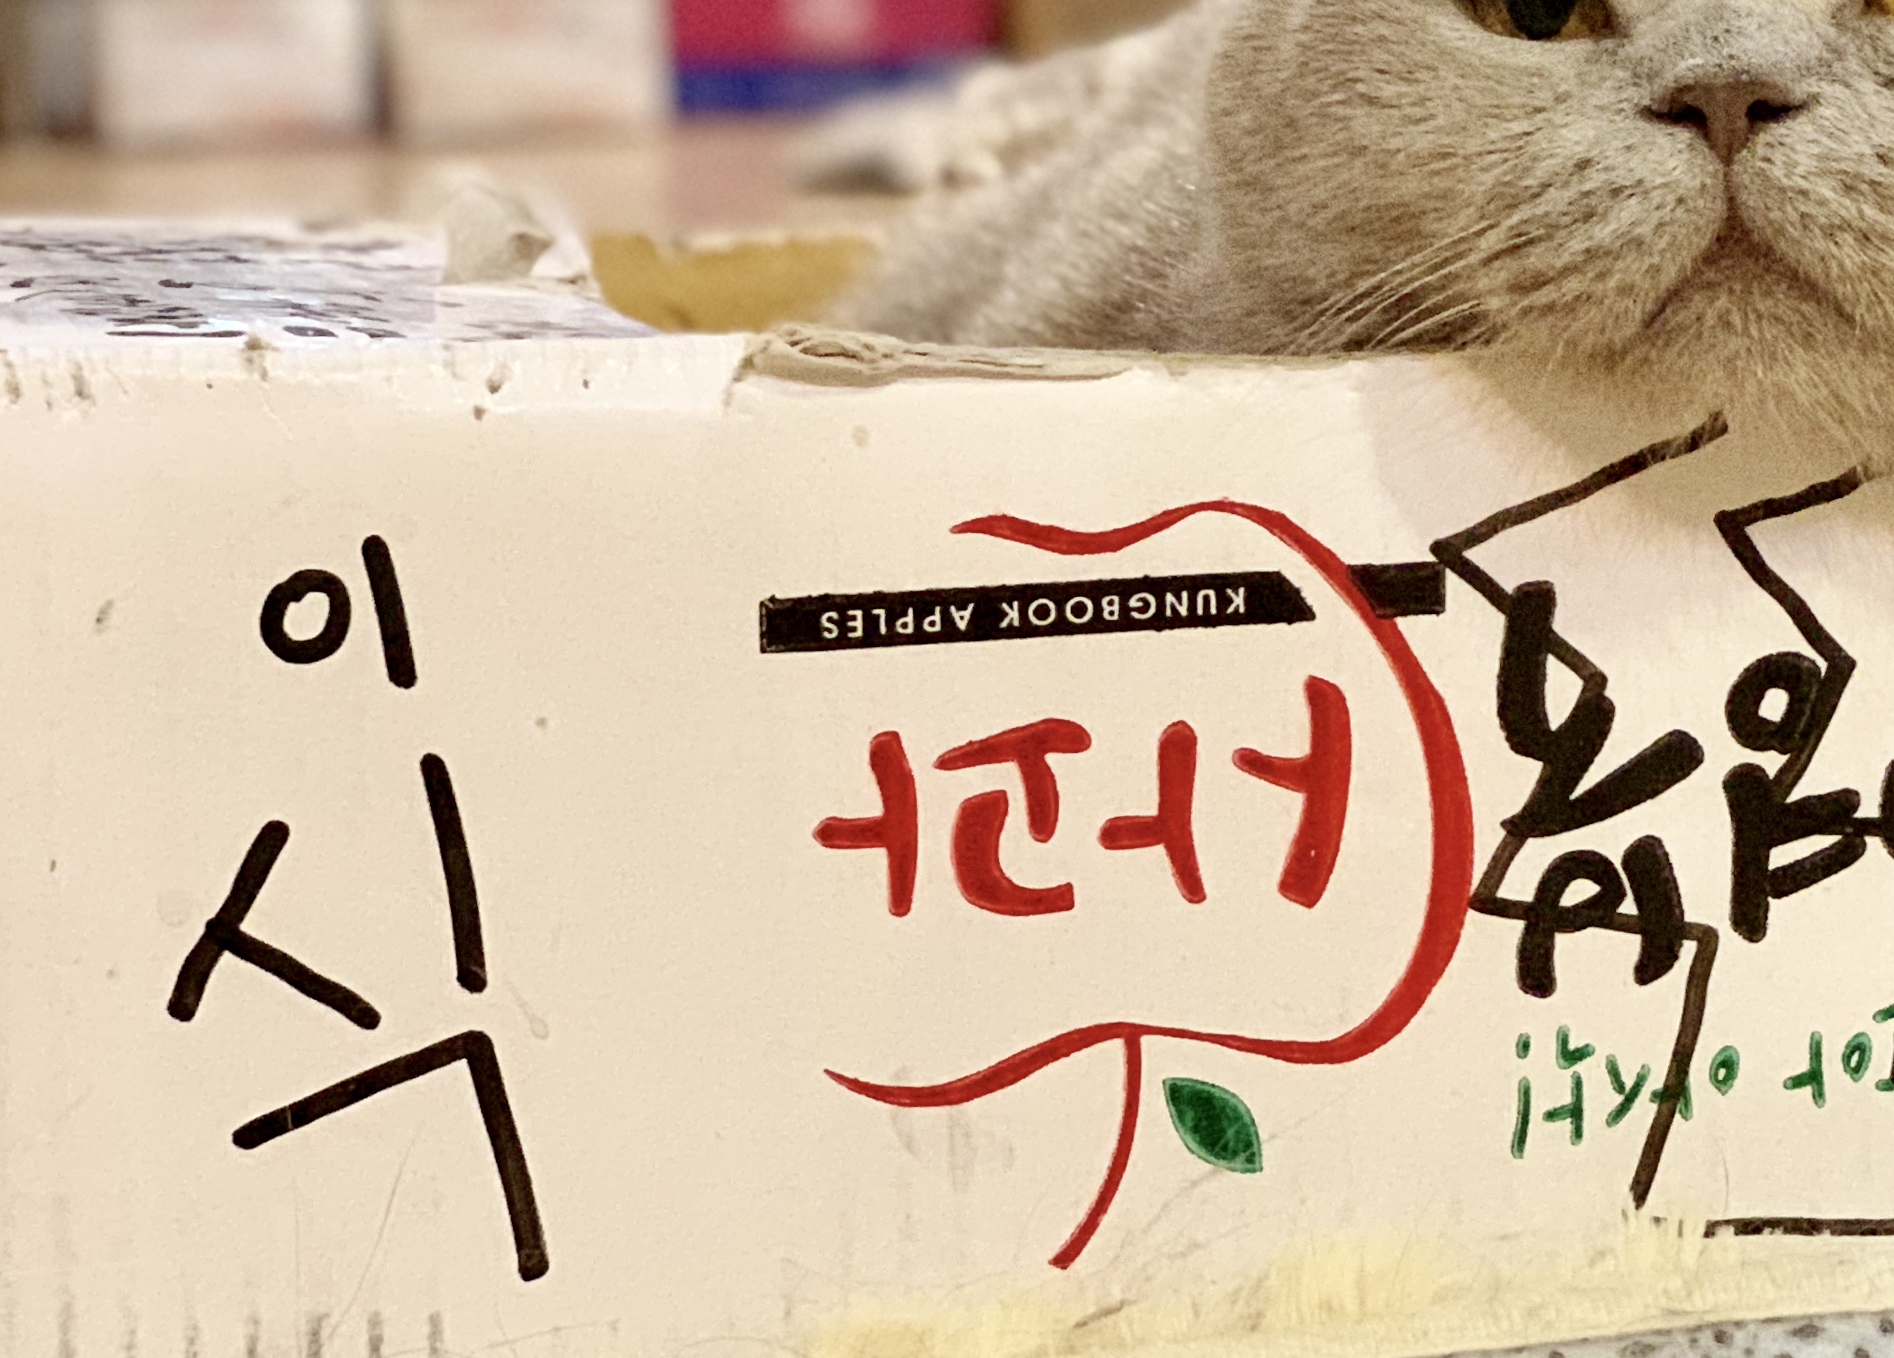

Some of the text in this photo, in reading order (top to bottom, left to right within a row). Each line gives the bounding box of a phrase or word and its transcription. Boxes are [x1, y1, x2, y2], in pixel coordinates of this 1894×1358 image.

[820, 586, 1248, 641] KUNGBOOK APPLES
[812, 673, 1353, 918] 사과
